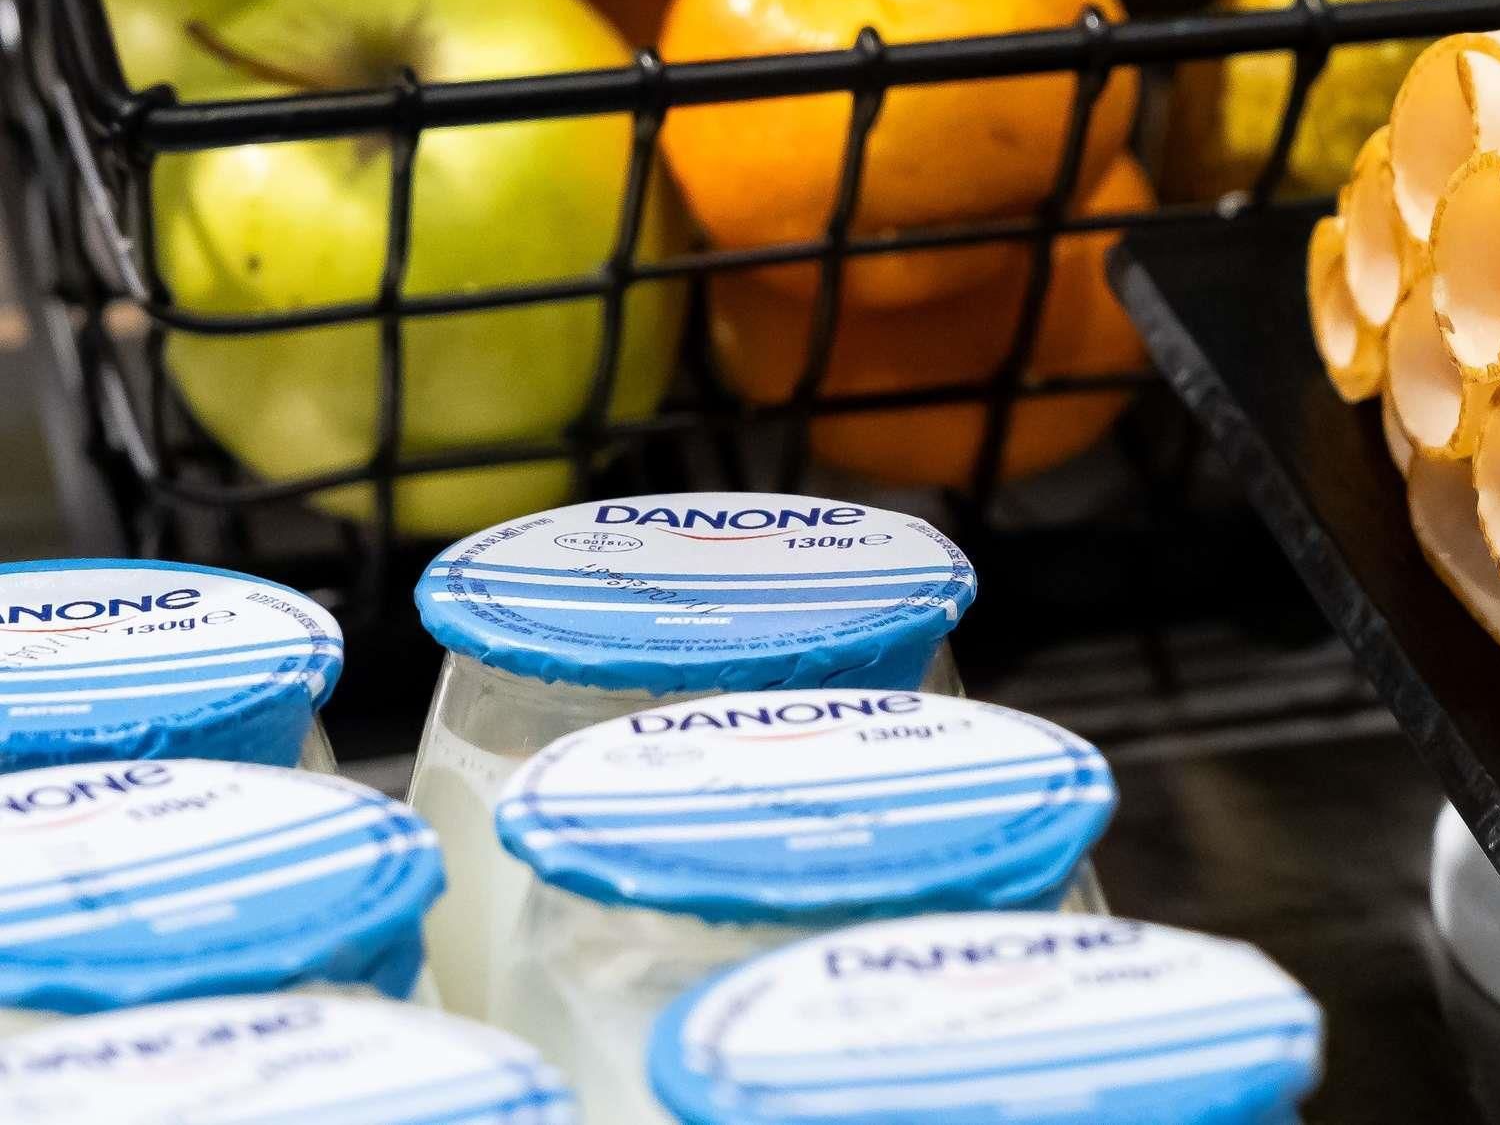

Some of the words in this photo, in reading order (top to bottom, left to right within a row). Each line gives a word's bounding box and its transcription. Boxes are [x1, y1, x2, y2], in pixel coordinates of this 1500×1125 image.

[595, 505, 866, 529] DANONE
[783, 536, 854, 549] 130g
[0, 588, 201, 625] NONE
[123, 615, 196, 635] 130g
[630, 693, 921, 734] DANONE
